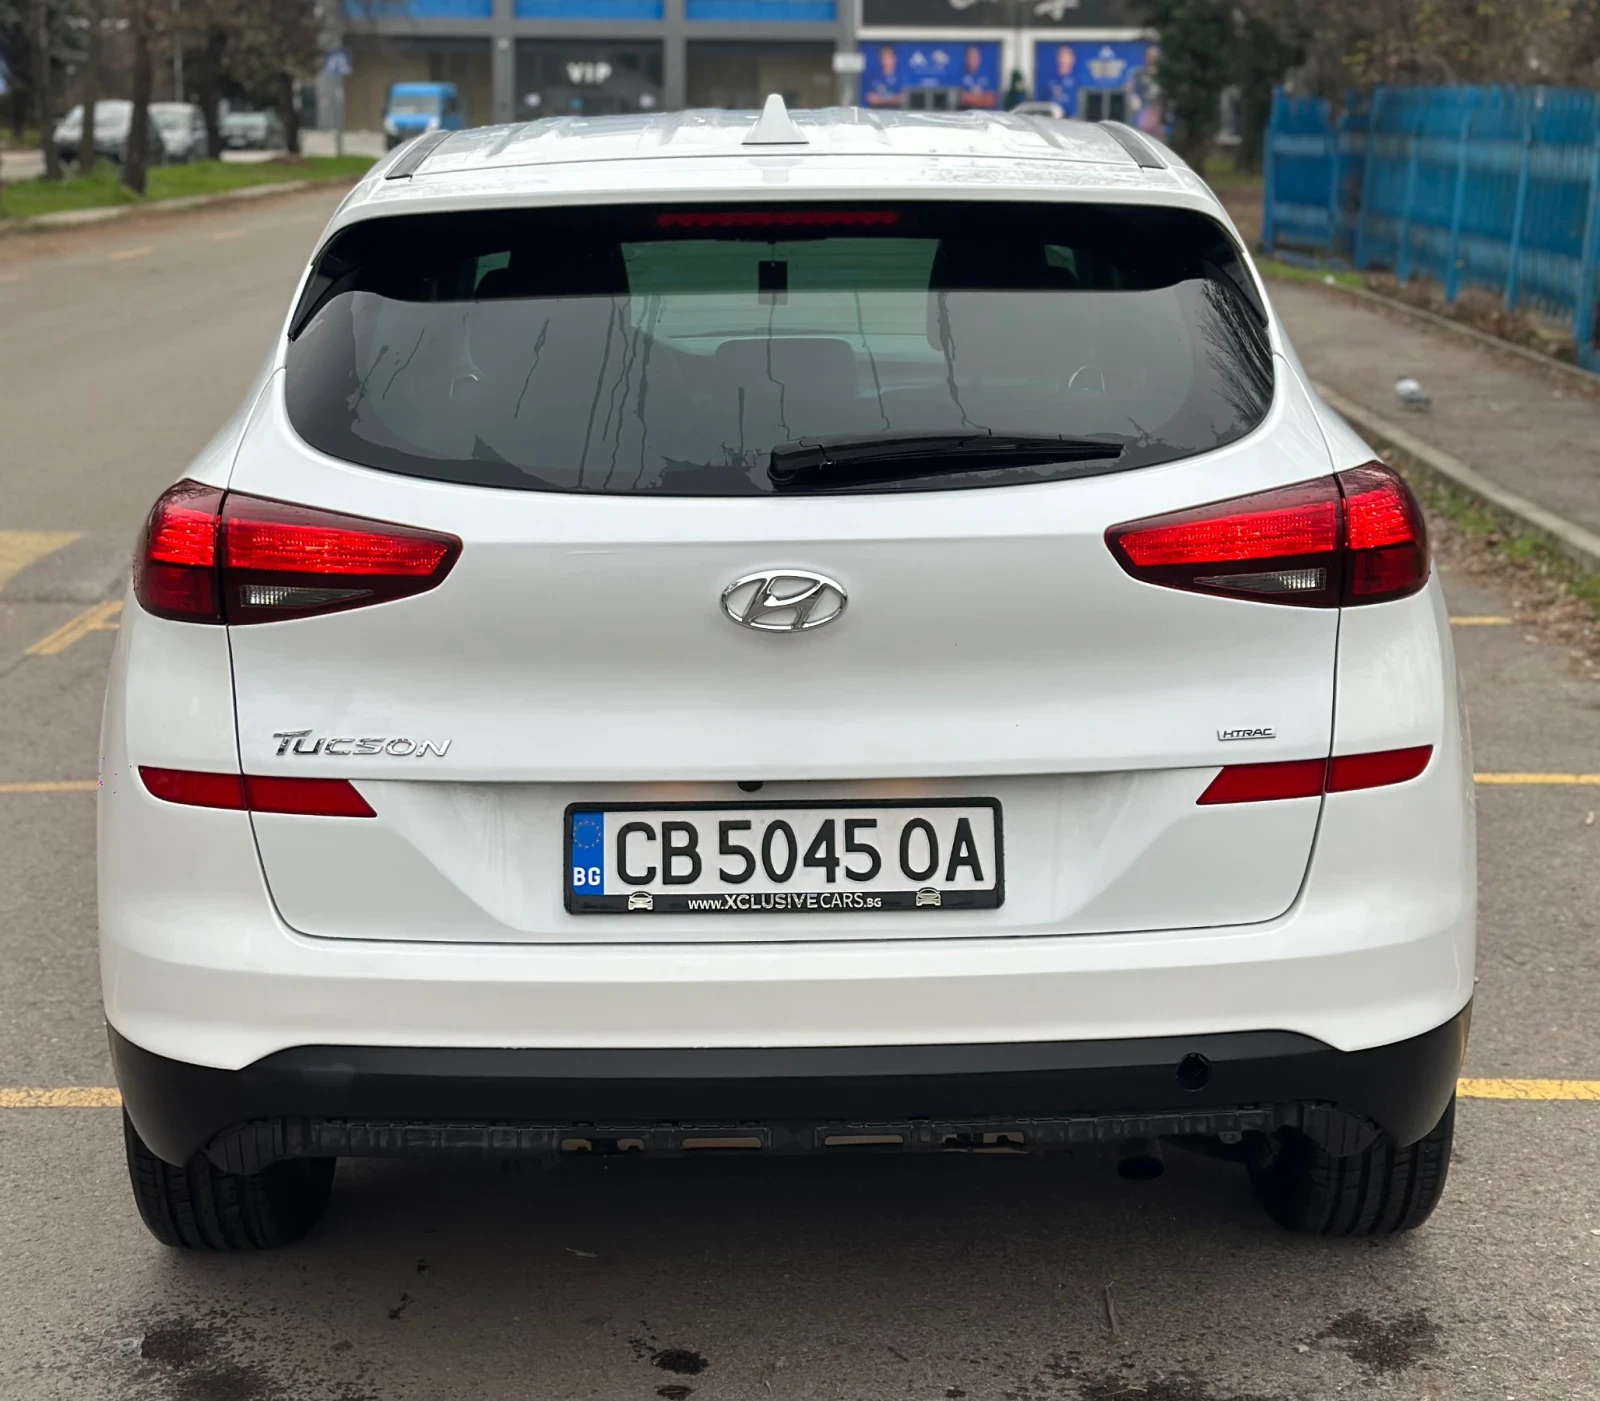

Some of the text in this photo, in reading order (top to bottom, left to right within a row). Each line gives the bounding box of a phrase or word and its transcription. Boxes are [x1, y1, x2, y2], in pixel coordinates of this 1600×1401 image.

[566, 61, 612, 84] VIP
[1223, 728, 1272, 738] HTRAC
[617, 818, 984, 885] CB 5045 OA
[573, 867, 601, 886] BG
